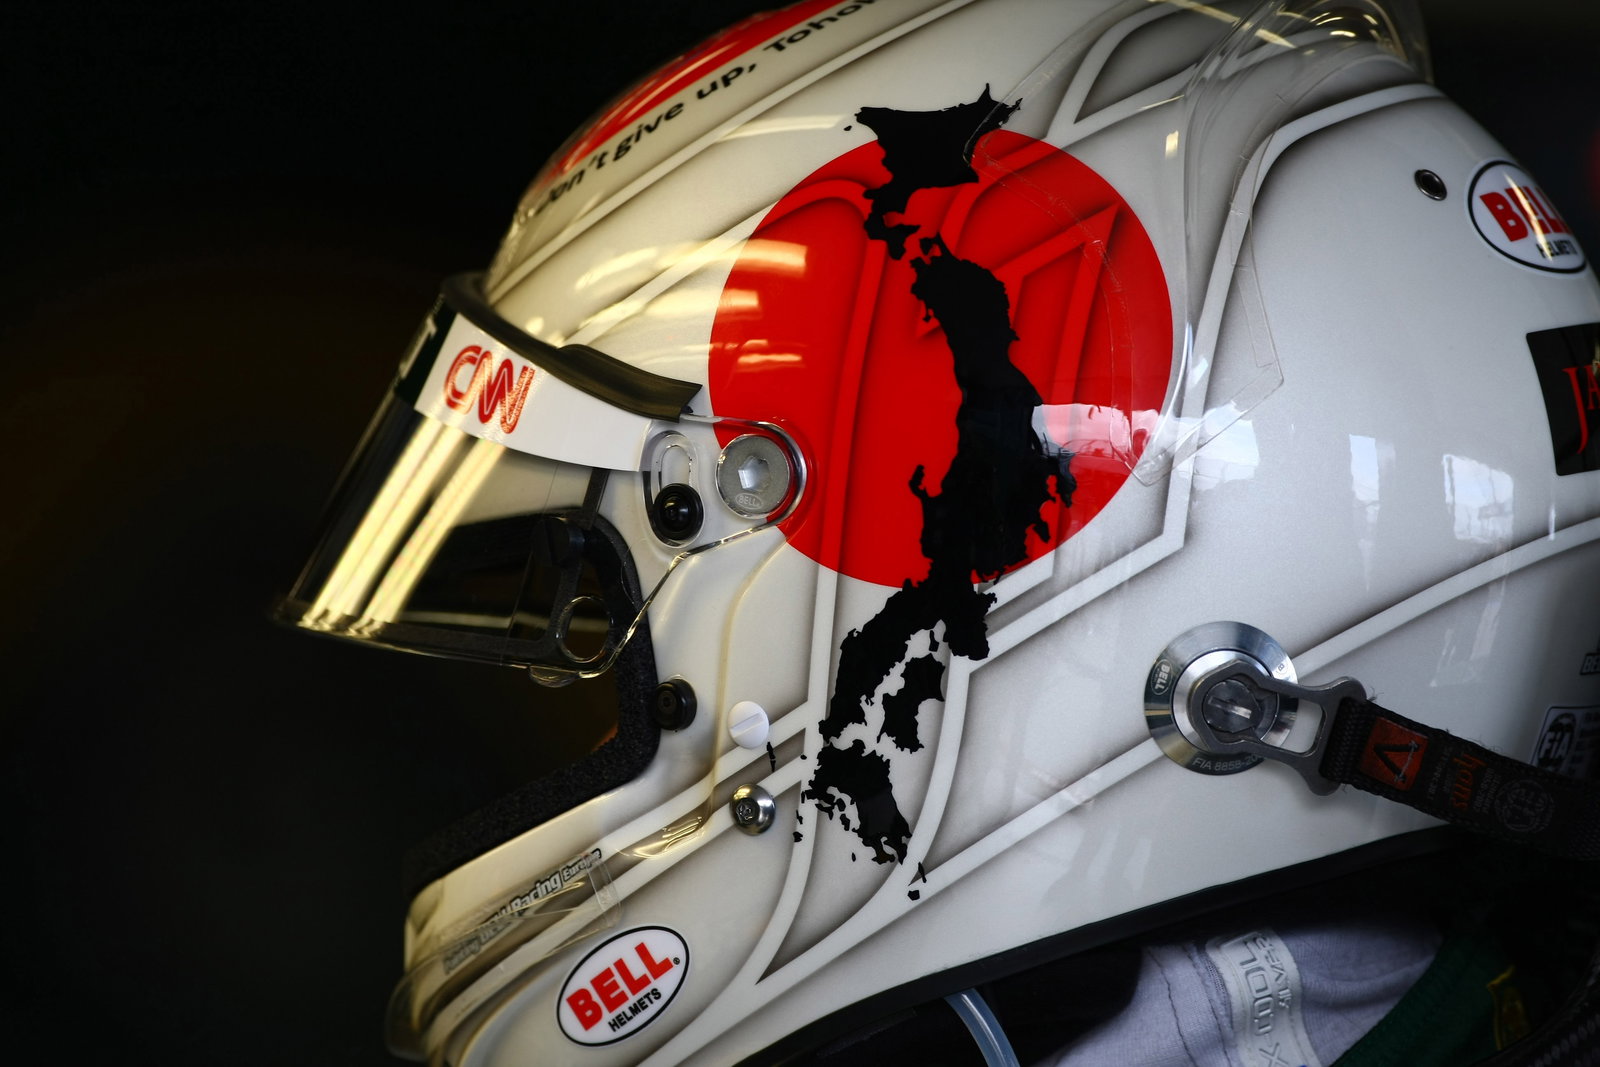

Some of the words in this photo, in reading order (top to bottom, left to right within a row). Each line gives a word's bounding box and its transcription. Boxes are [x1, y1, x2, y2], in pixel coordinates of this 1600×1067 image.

[612, 102, 685, 162] give
[696, 63, 757, 101] up,
[762, 0, 876, 52] Toho
[443, 345, 536, 434] CNN
[1561, 364, 1600, 455] JA
[739, 495, 757, 506] BELL
[1154, 663, 1171, 691] BELL
[1191, 756, 1212, 771] FIA
[510, 870, 563, 916] Racing
[566, 942, 674, 1031] BELL
[608, 988, 662, 1032] HELMETS
